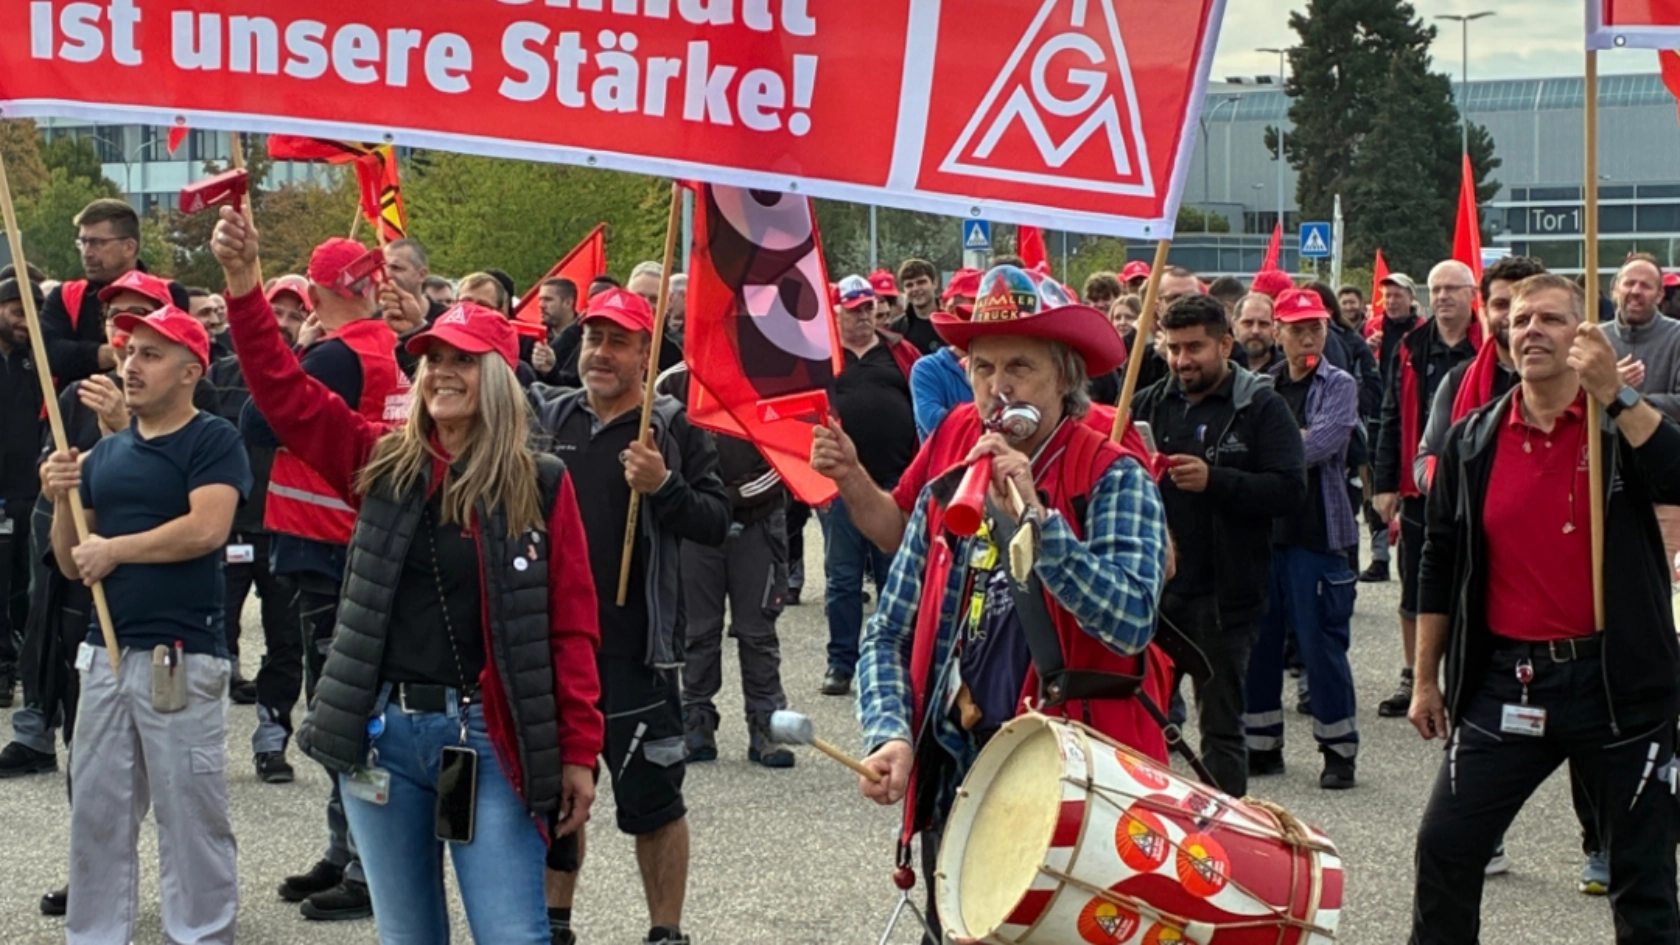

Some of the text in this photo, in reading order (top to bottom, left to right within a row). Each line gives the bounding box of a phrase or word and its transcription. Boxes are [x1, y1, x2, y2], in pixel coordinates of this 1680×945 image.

[30, 0, 143, 66] ist
[171, 10, 473, 94] unsere
[498, 21, 819, 136] Stärke!
[1532, 209, 1578, 231] Tor 1
[977, 294, 1035, 308] AIMLER
